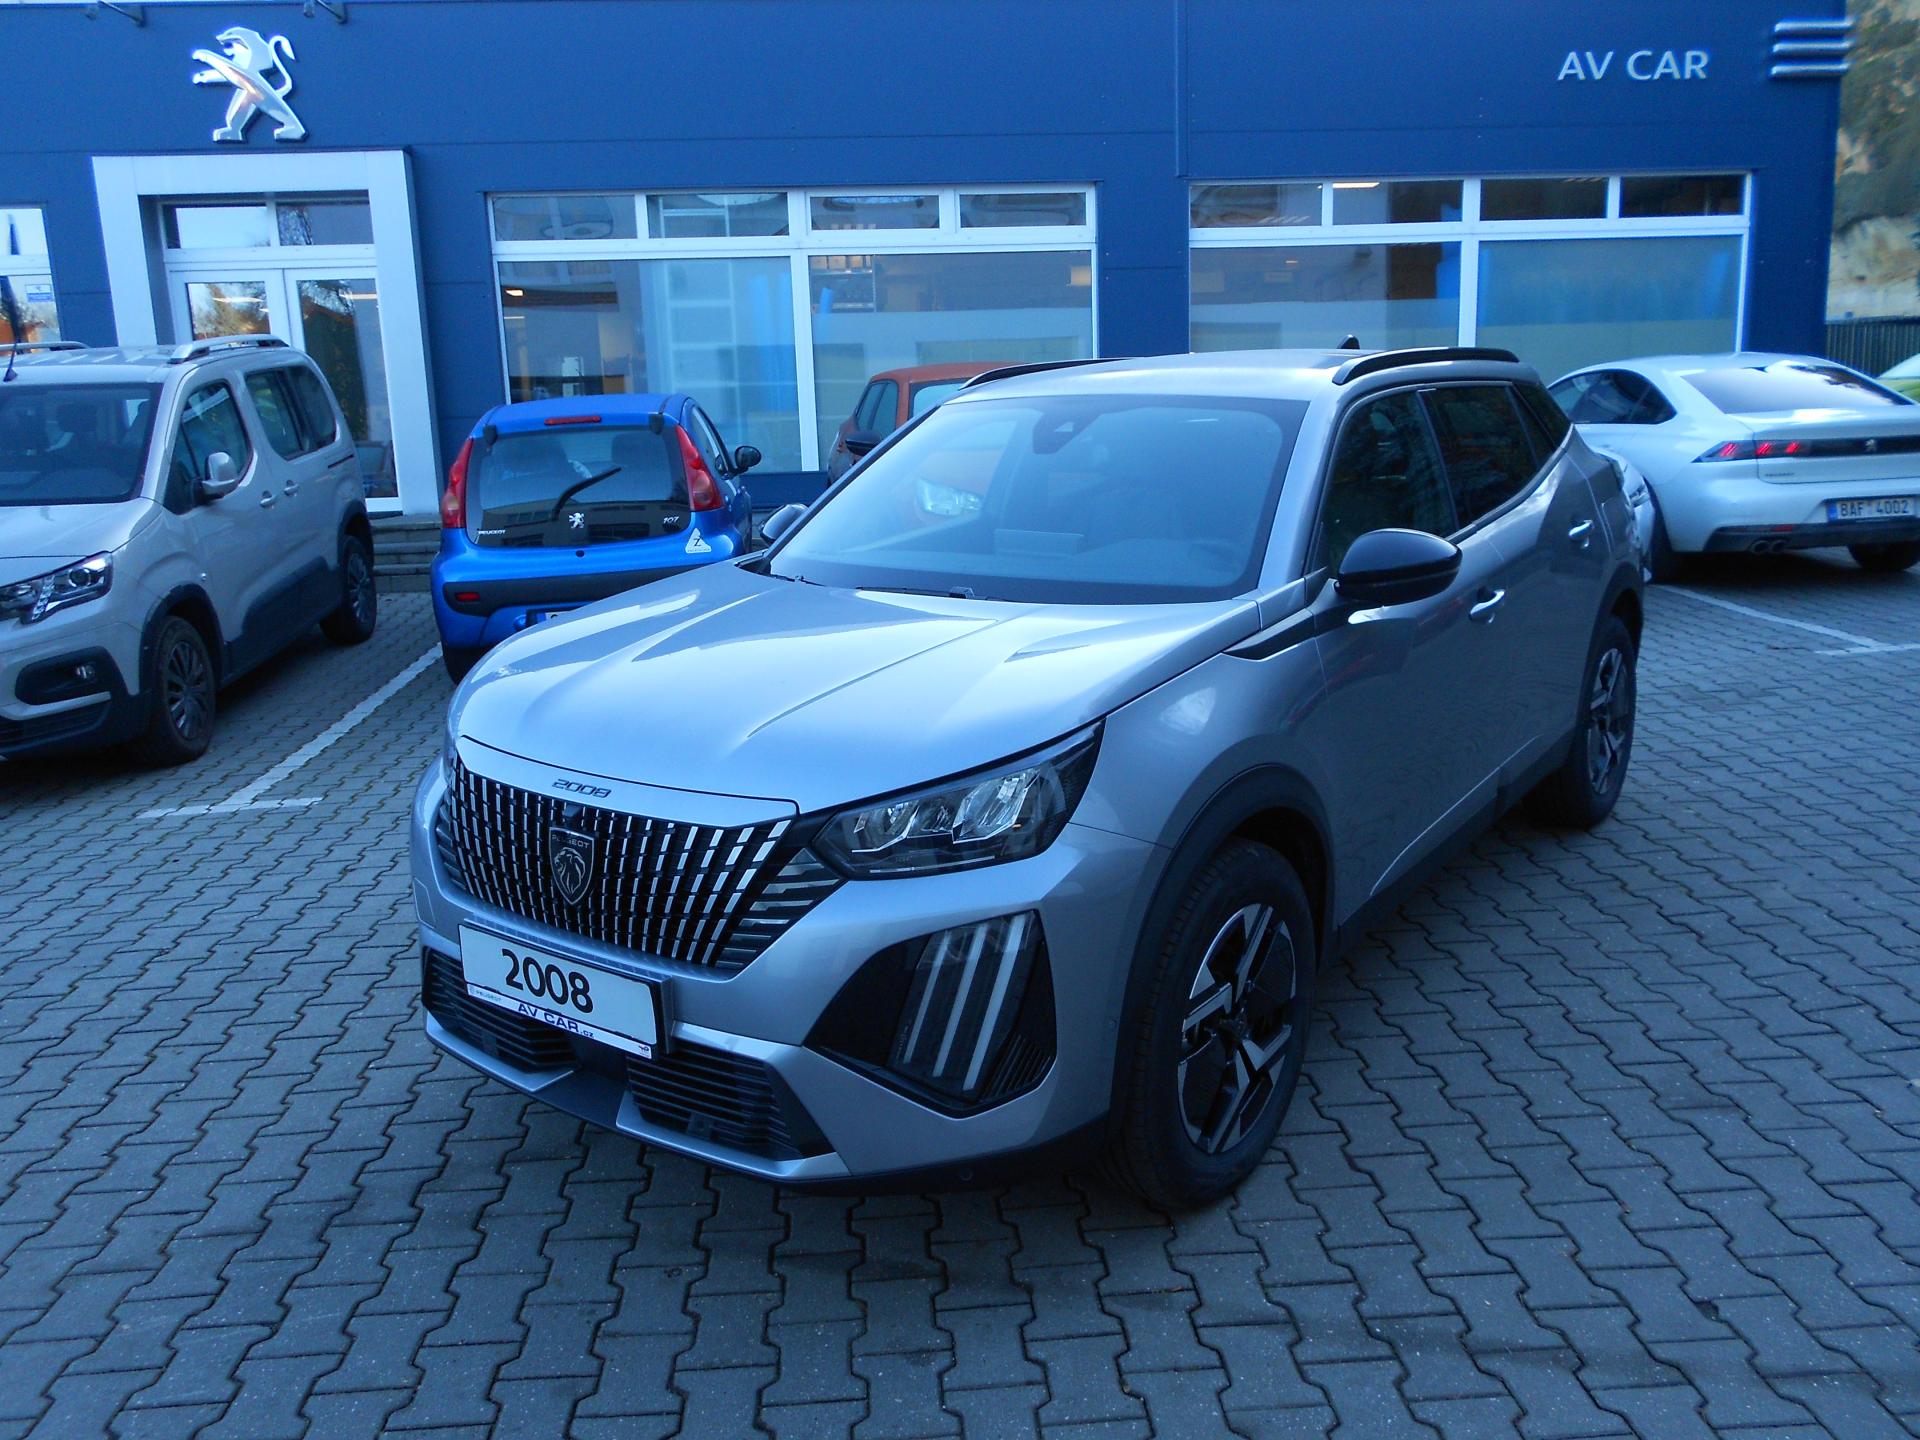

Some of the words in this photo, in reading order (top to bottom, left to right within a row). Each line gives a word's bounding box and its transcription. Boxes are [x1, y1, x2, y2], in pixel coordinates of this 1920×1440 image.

[1557, 51, 1614, 80] AV
[1627, 50, 1709, 80] CAR
[1876, 500, 1909, 514] 4002
[663, 516, 679, 524] 107
[552, 779, 612, 798] 2008
[502, 948, 594, 1014] 2008
[518, 1002, 538, 1018] AV
